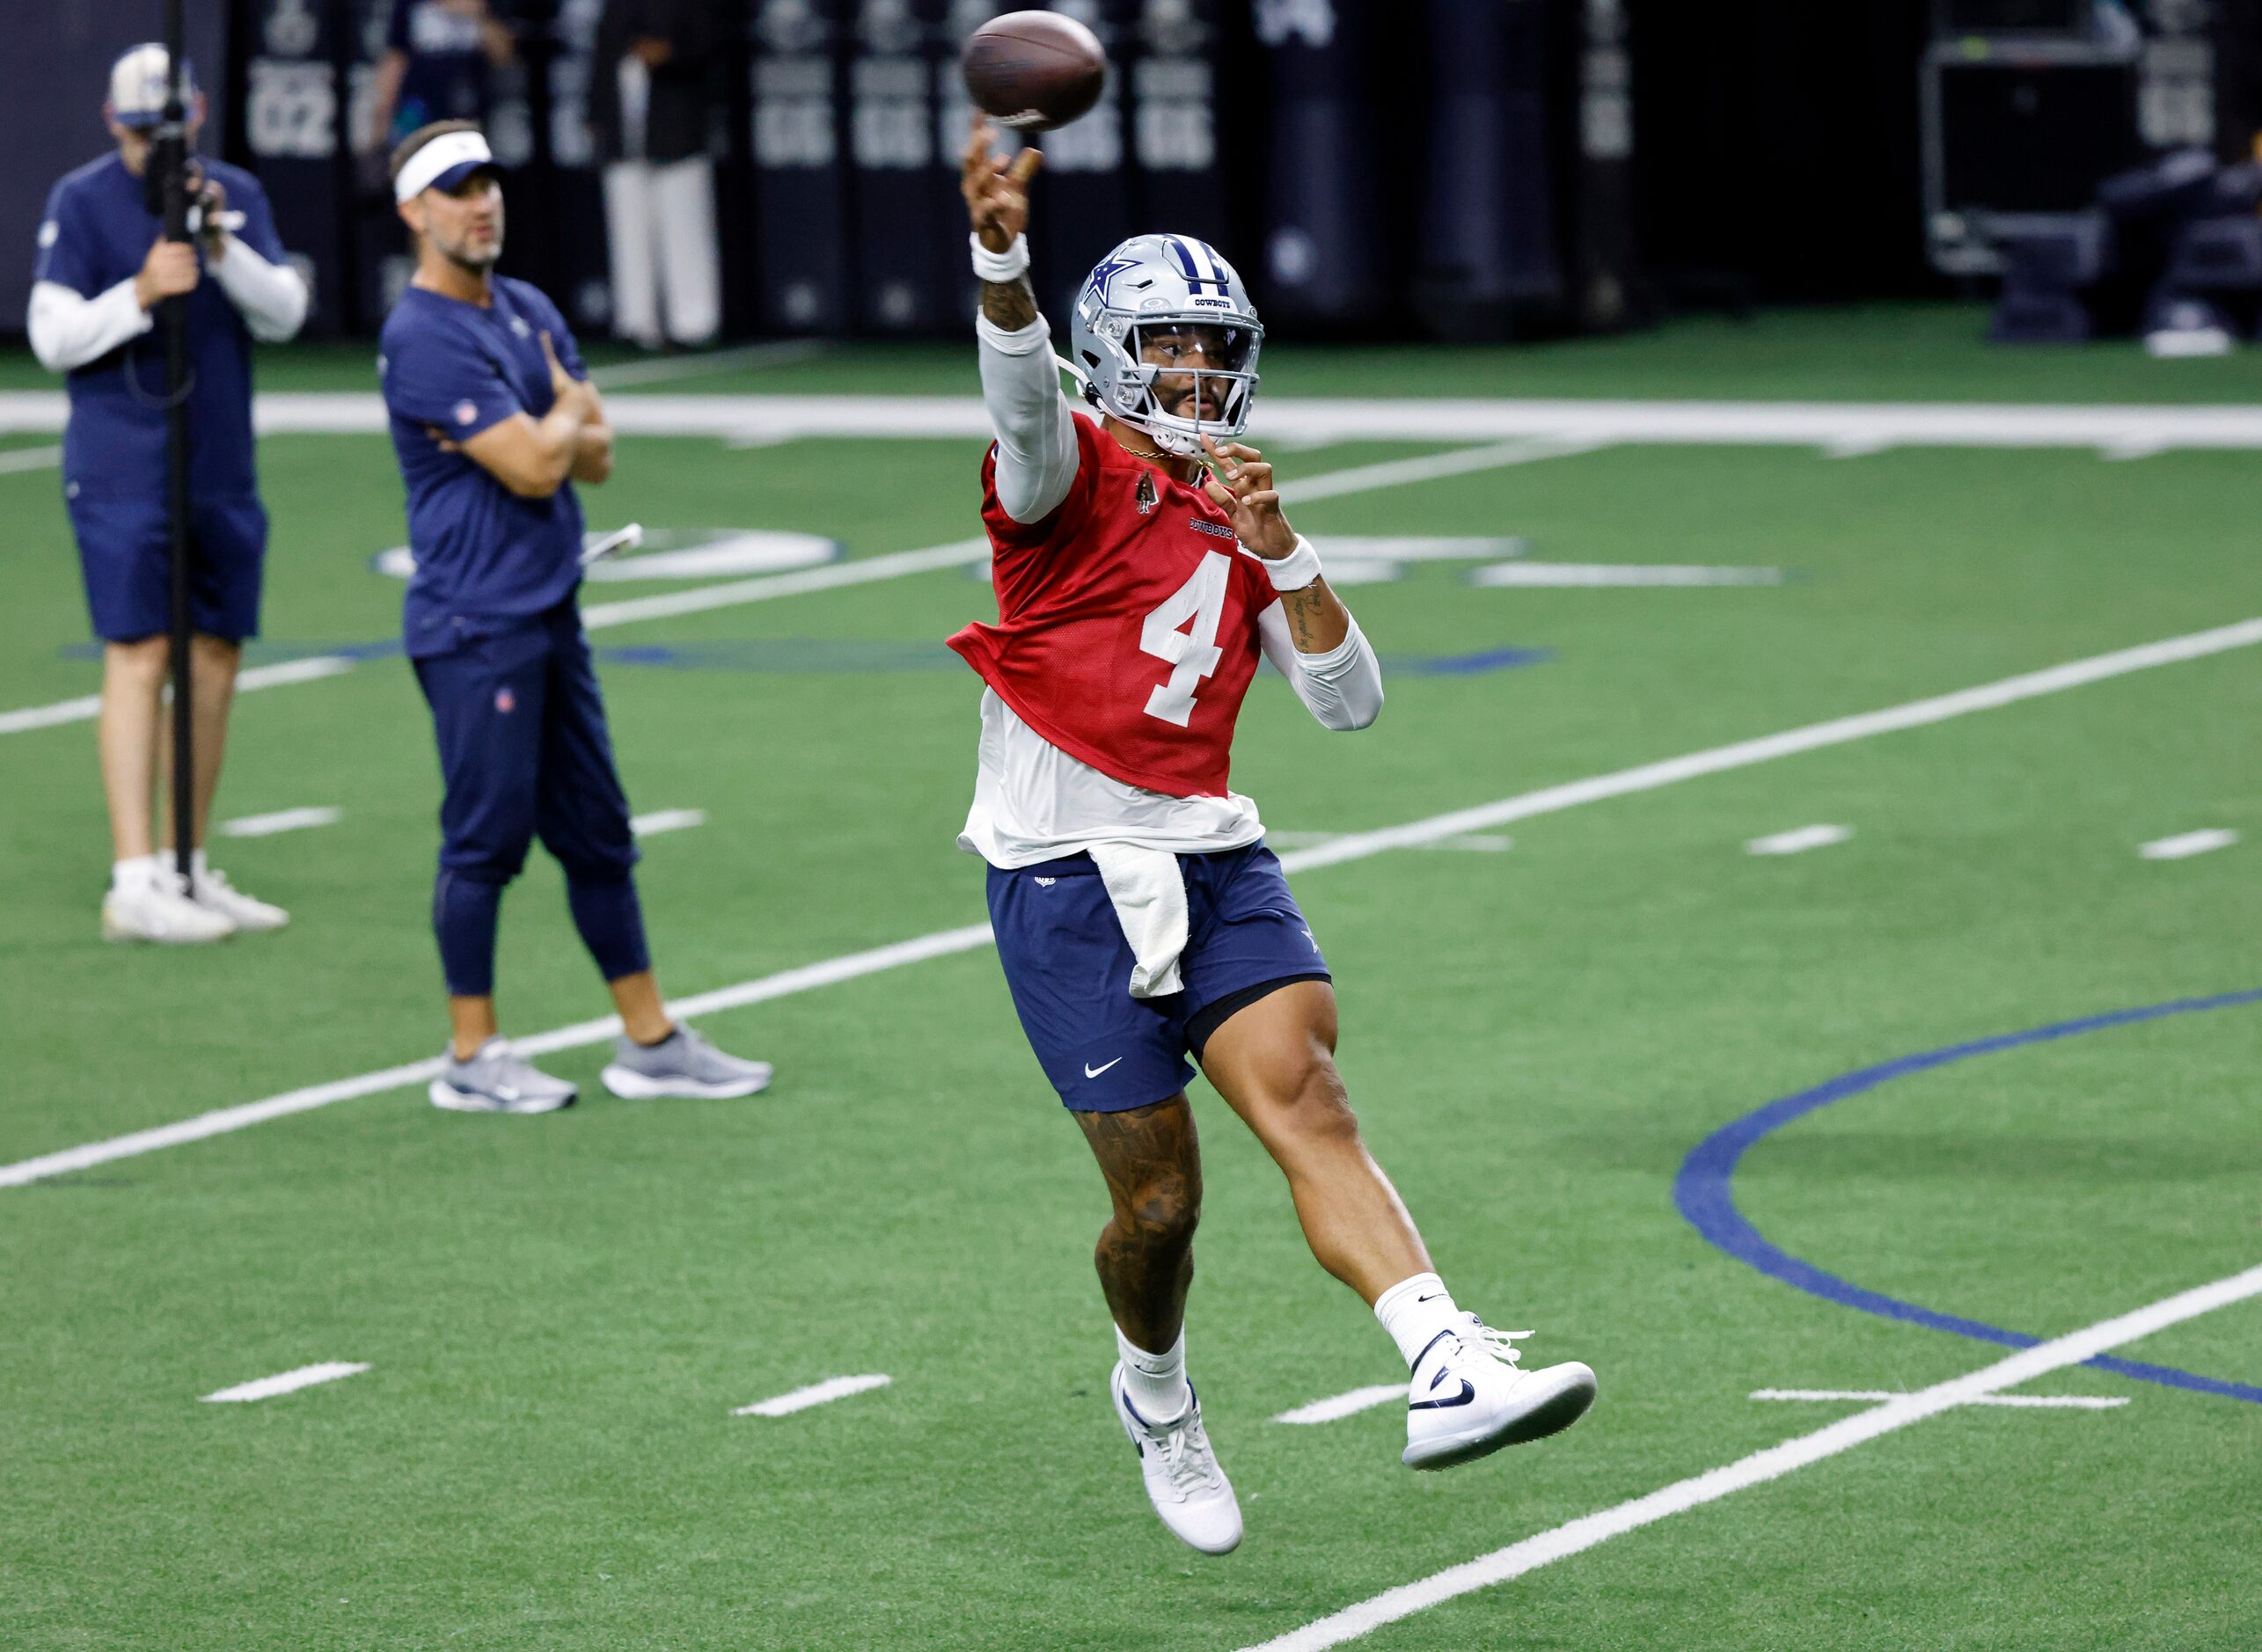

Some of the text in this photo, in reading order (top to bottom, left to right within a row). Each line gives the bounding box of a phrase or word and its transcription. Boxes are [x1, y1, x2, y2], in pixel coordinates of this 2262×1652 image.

[1195, 299, 1230, 308] COWBOYS
[1190, 517, 1233, 540] COWBOYS
[1139, 550, 1232, 727] 4
